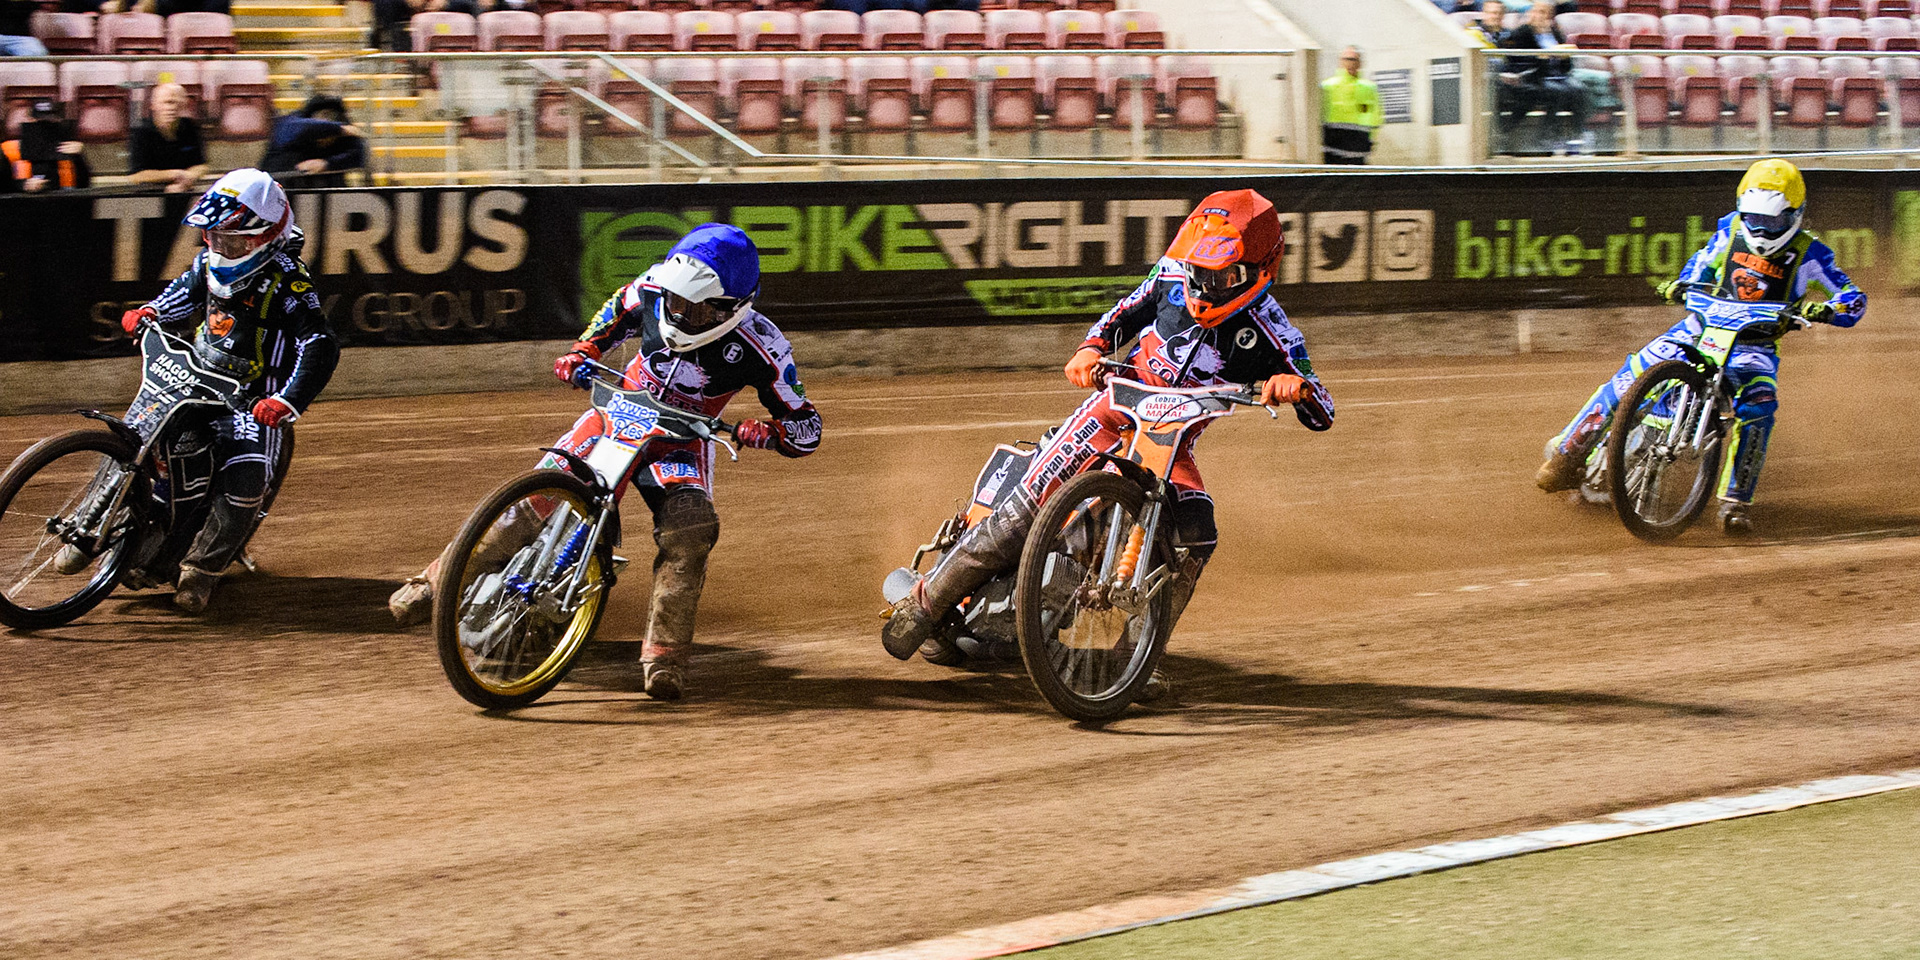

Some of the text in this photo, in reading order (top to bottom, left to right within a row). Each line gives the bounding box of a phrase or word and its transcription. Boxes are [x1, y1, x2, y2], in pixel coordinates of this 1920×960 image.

[92, 189, 529, 282] TRUS
[1784, 252, 1796, 265] 7
[258, 279, 271, 293] 3
[352, 288, 526, 334] GROUP
[155, 353, 201, 387] HAGON
[1030, 455, 1065, 497] Adrian
[1060, 443, 1074, 456] &
